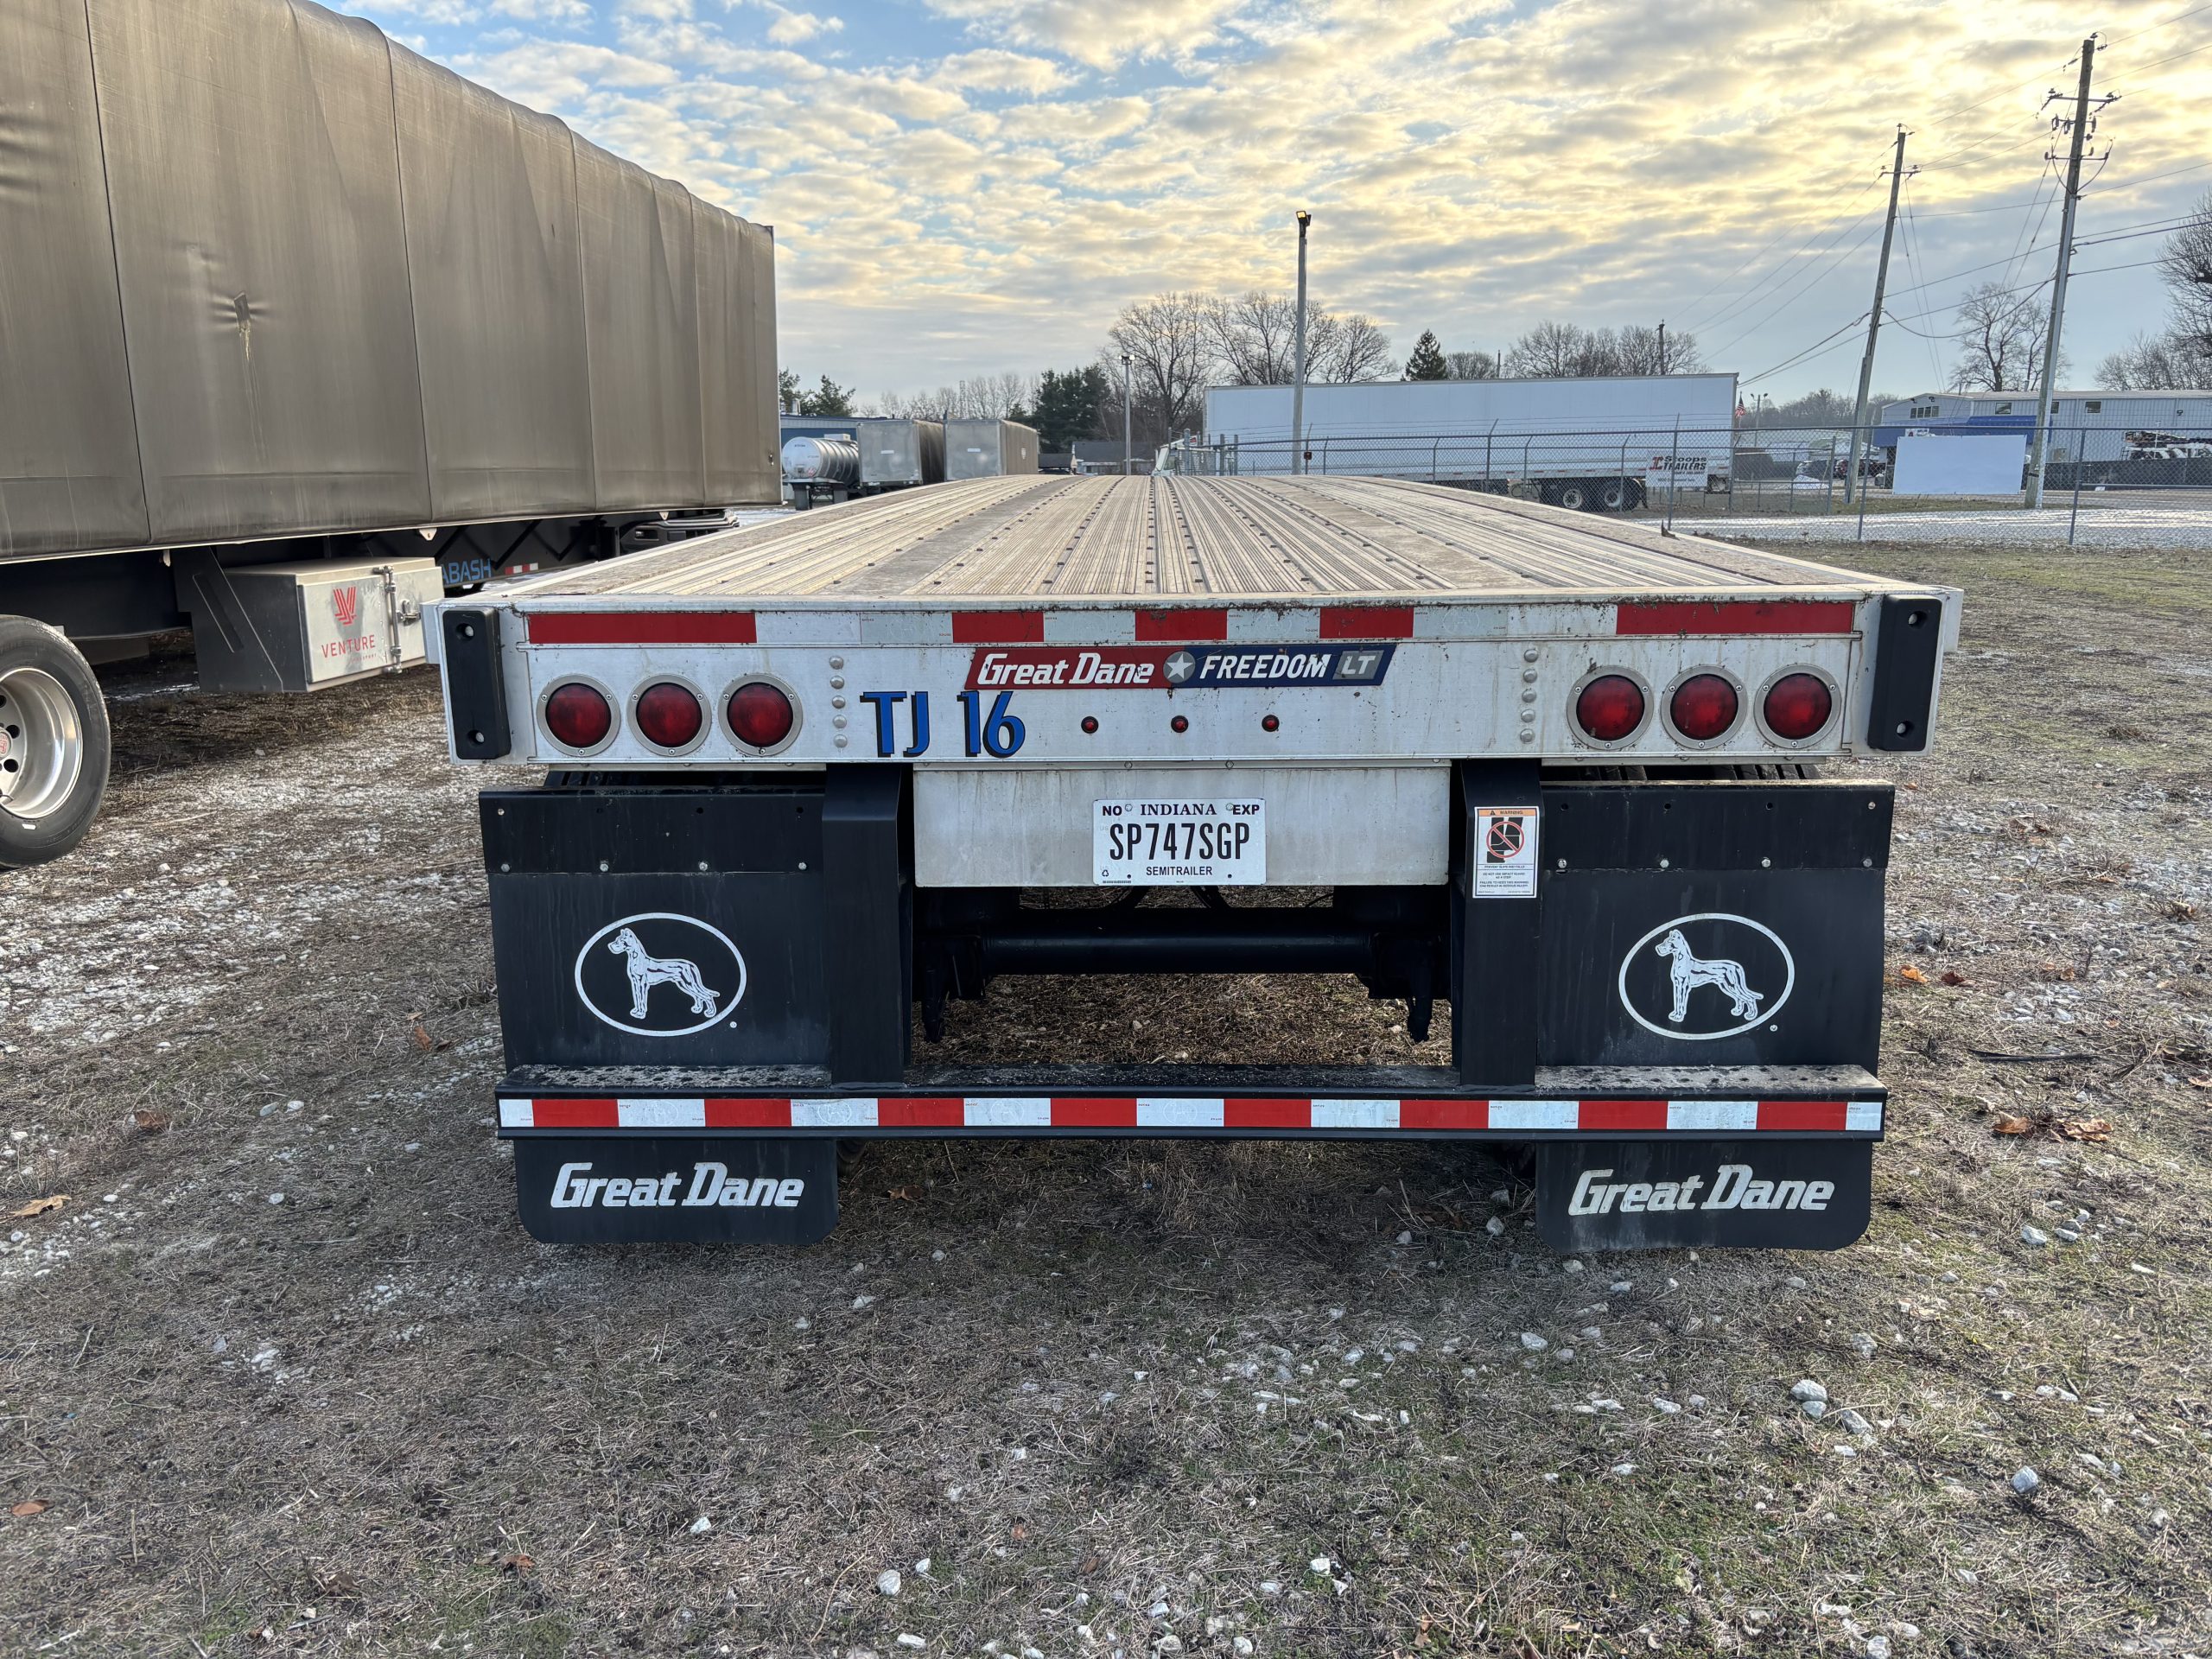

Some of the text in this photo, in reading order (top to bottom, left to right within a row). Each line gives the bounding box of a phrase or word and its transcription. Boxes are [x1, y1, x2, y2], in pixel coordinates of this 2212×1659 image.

[1663, 455, 1707, 464] Soops
[321, 634, 376, 658] VENTURE
[977, 652, 1377, 685] Great Dane FREEDOM LT
[860, 691, 1026, 759] TJ 16
[1102, 804, 1260, 816] NO INDIANA EXP
[1109, 823, 1250, 861] SP747SGP
[1146, 866, 1213, 876] SEMITRAILER
[550, 1162, 804, 1209] Great Dane
[1568, 1164, 1835, 1217] Great Dane
